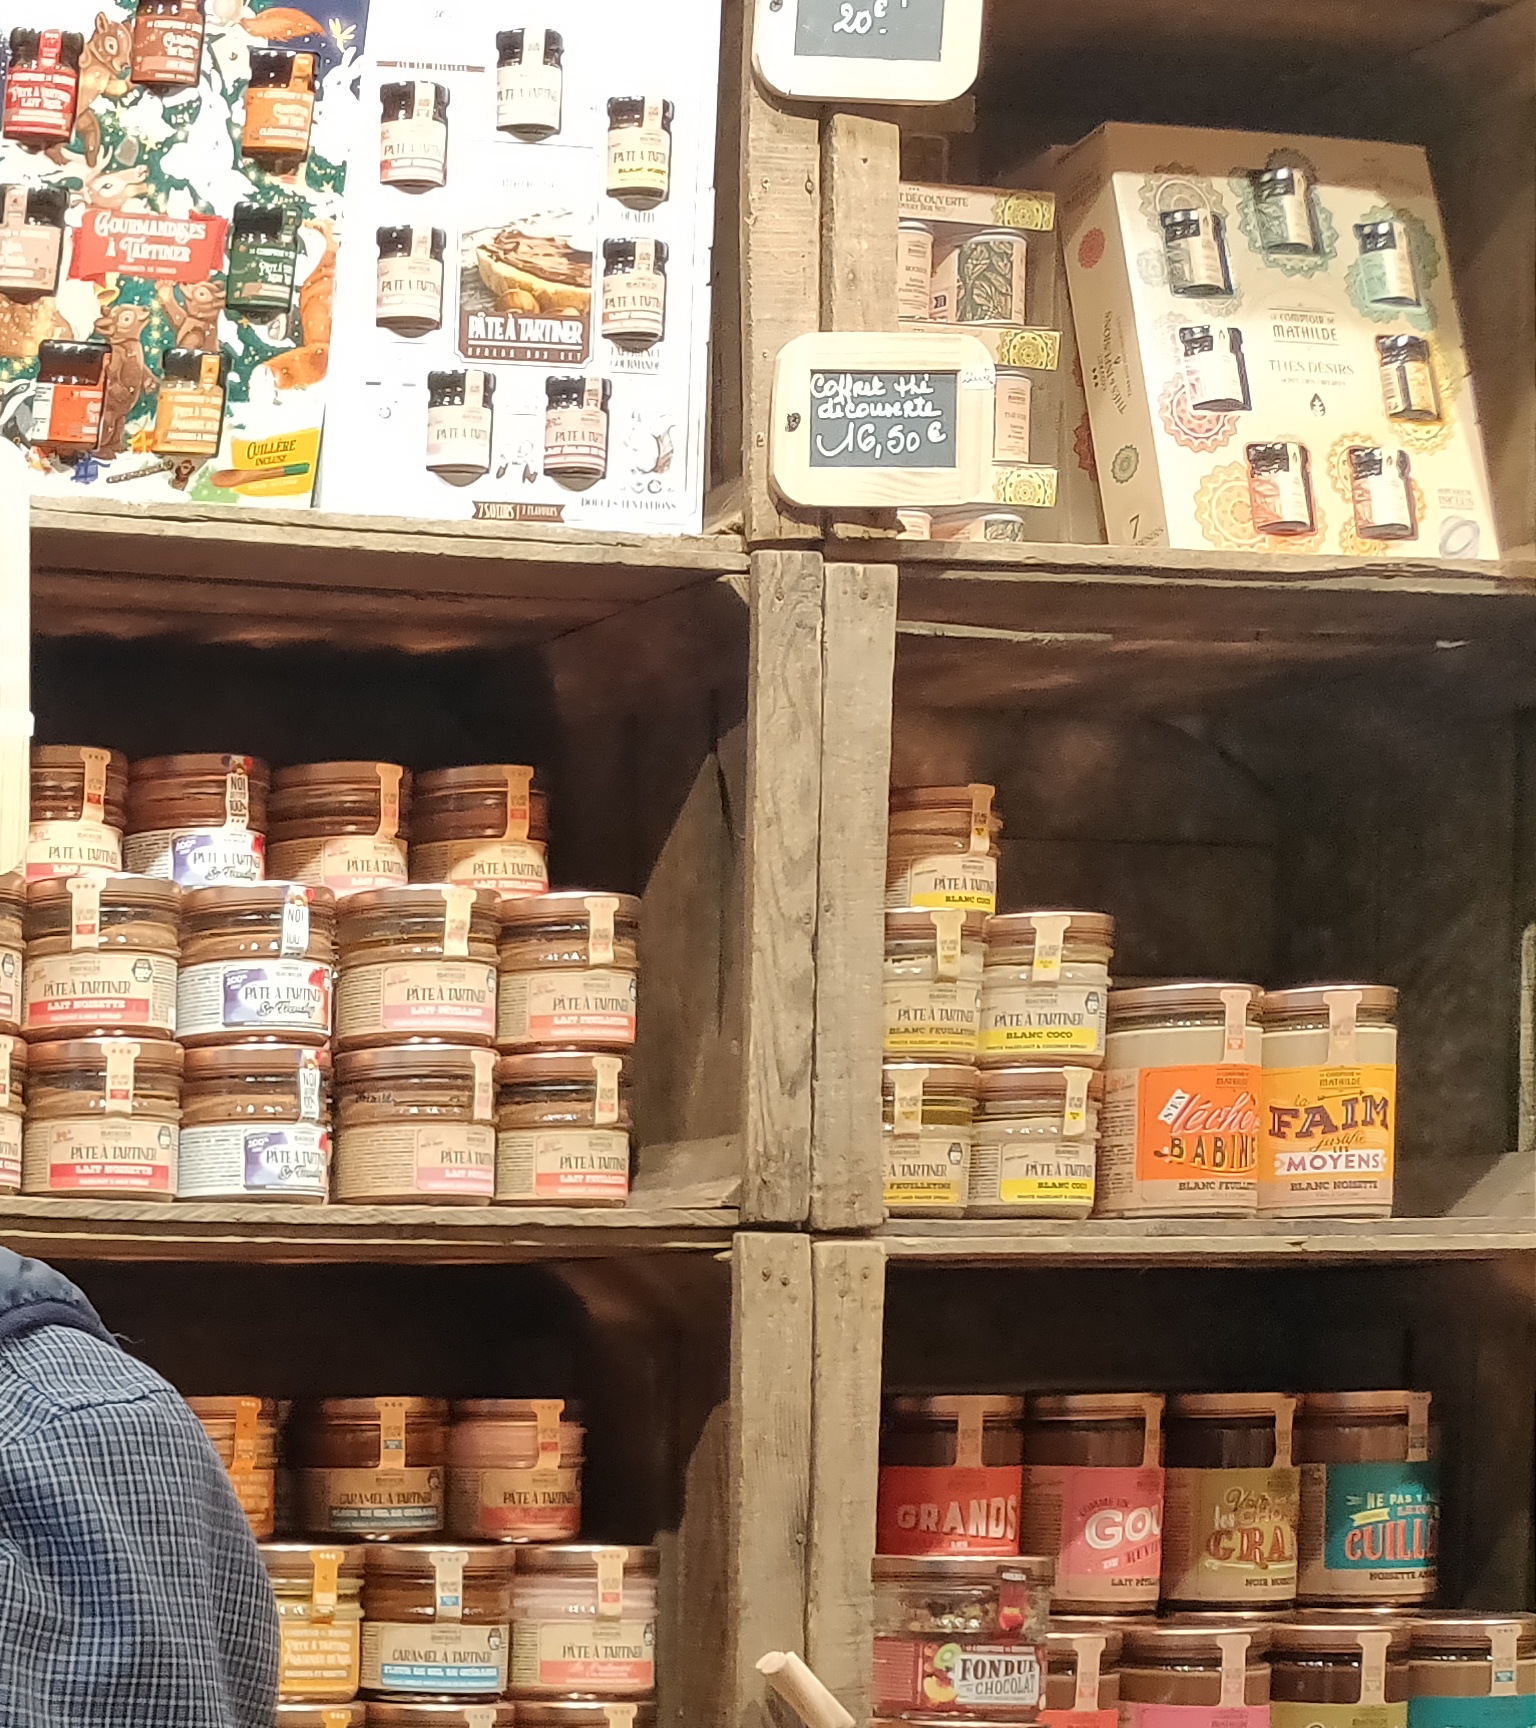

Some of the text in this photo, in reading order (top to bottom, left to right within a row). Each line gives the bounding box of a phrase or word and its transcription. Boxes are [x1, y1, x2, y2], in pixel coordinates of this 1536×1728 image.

[94, 211, 207, 243] GOURMANDISES
[119, 237, 191, 263] TARTINER
[468, 312, 503, 341] PÂTE
[517, 318, 583, 343] TARTINER
[1273, 325, 1337, 341] MATHILDE
[811, 374, 934, 404] Coffret thé
[79, 980, 131, 995] TARTINER
[1006, 1030, 1073, 1039] BLANC COCO
[1268, 1095, 1389, 1139] FAIM
[1286, 1154, 1380, 1172] MOYENS
[1178, 1182, 1215, 1191] BLANC
[1290, 1183, 1329, 1191] BLANC
[896, 1494, 1018, 1541] GRANDS
[959, 1658, 1037, 1682] FONDUE
